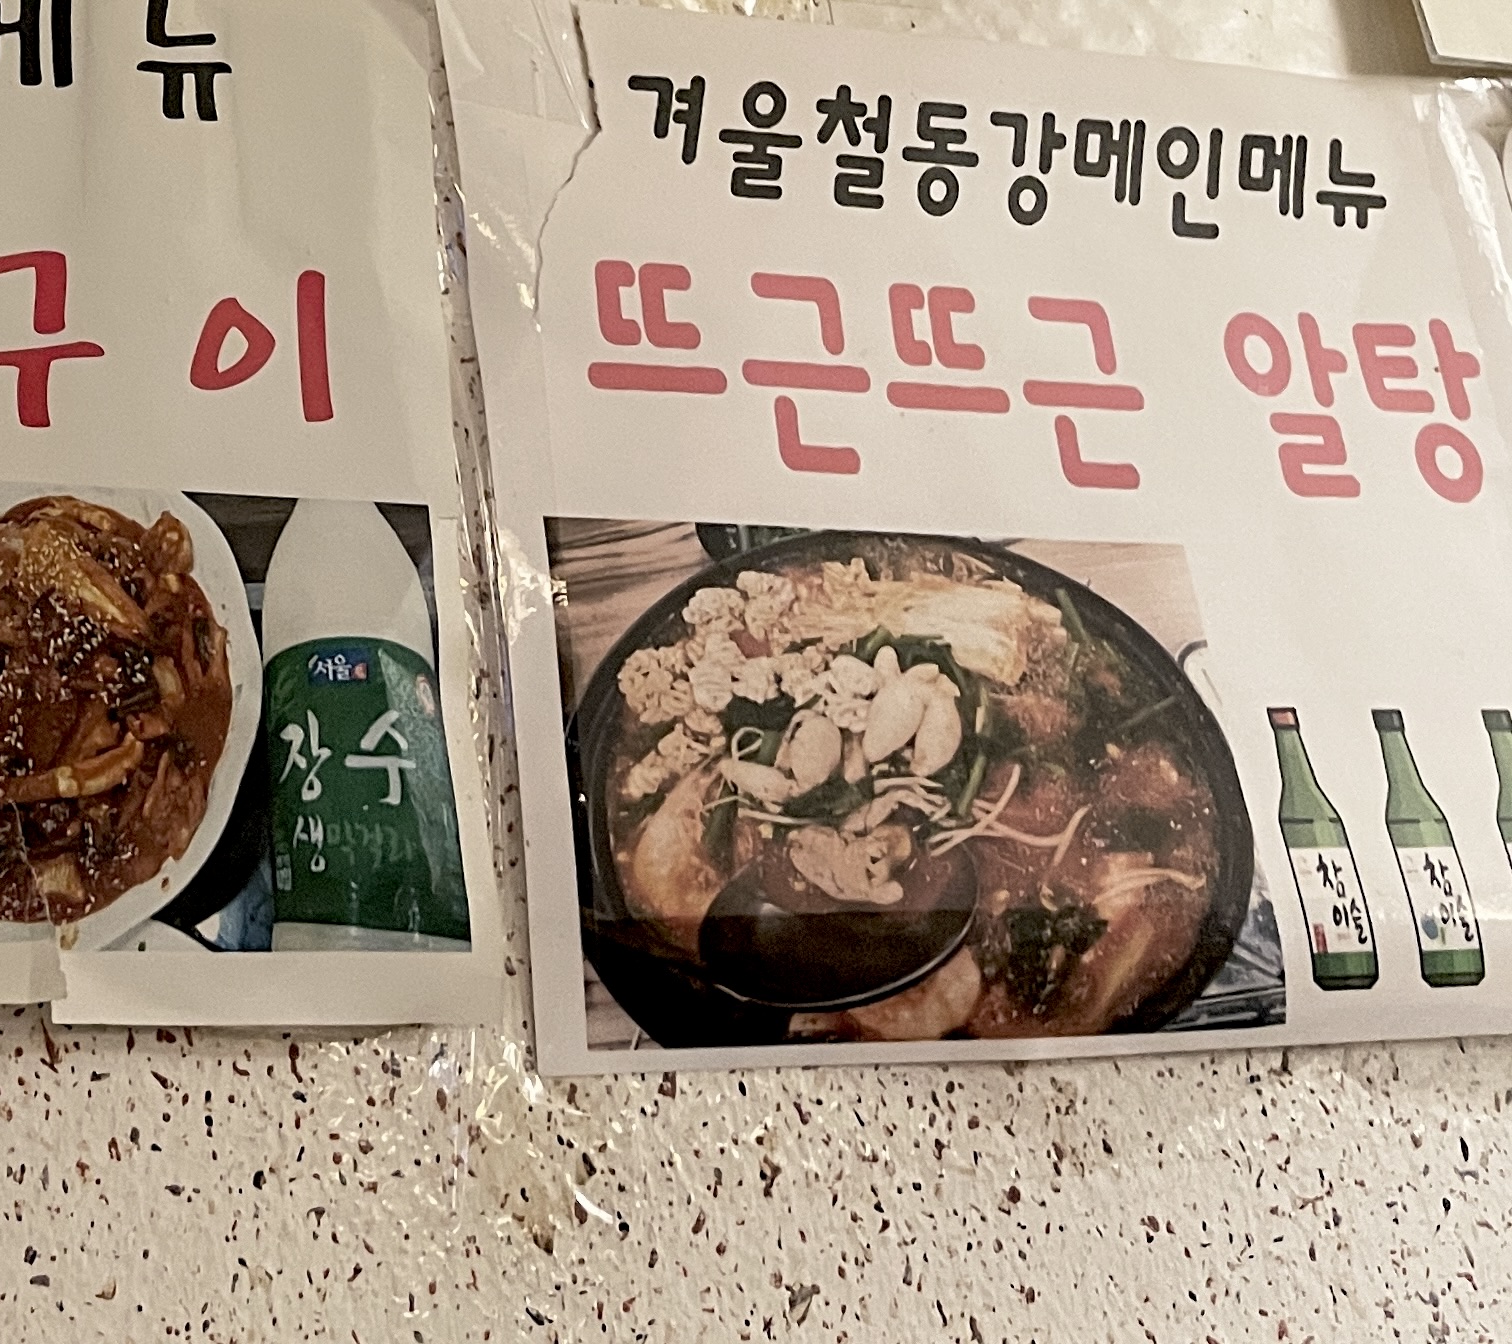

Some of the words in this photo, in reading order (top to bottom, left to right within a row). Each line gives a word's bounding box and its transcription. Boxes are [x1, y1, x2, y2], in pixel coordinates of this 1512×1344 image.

[627, 75, 1387, 239] 겨울철동강메인메뉴
[588, 260, 1144, 489] 뜨근뜨근
[1224, 312, 1483, 503] 알탕
